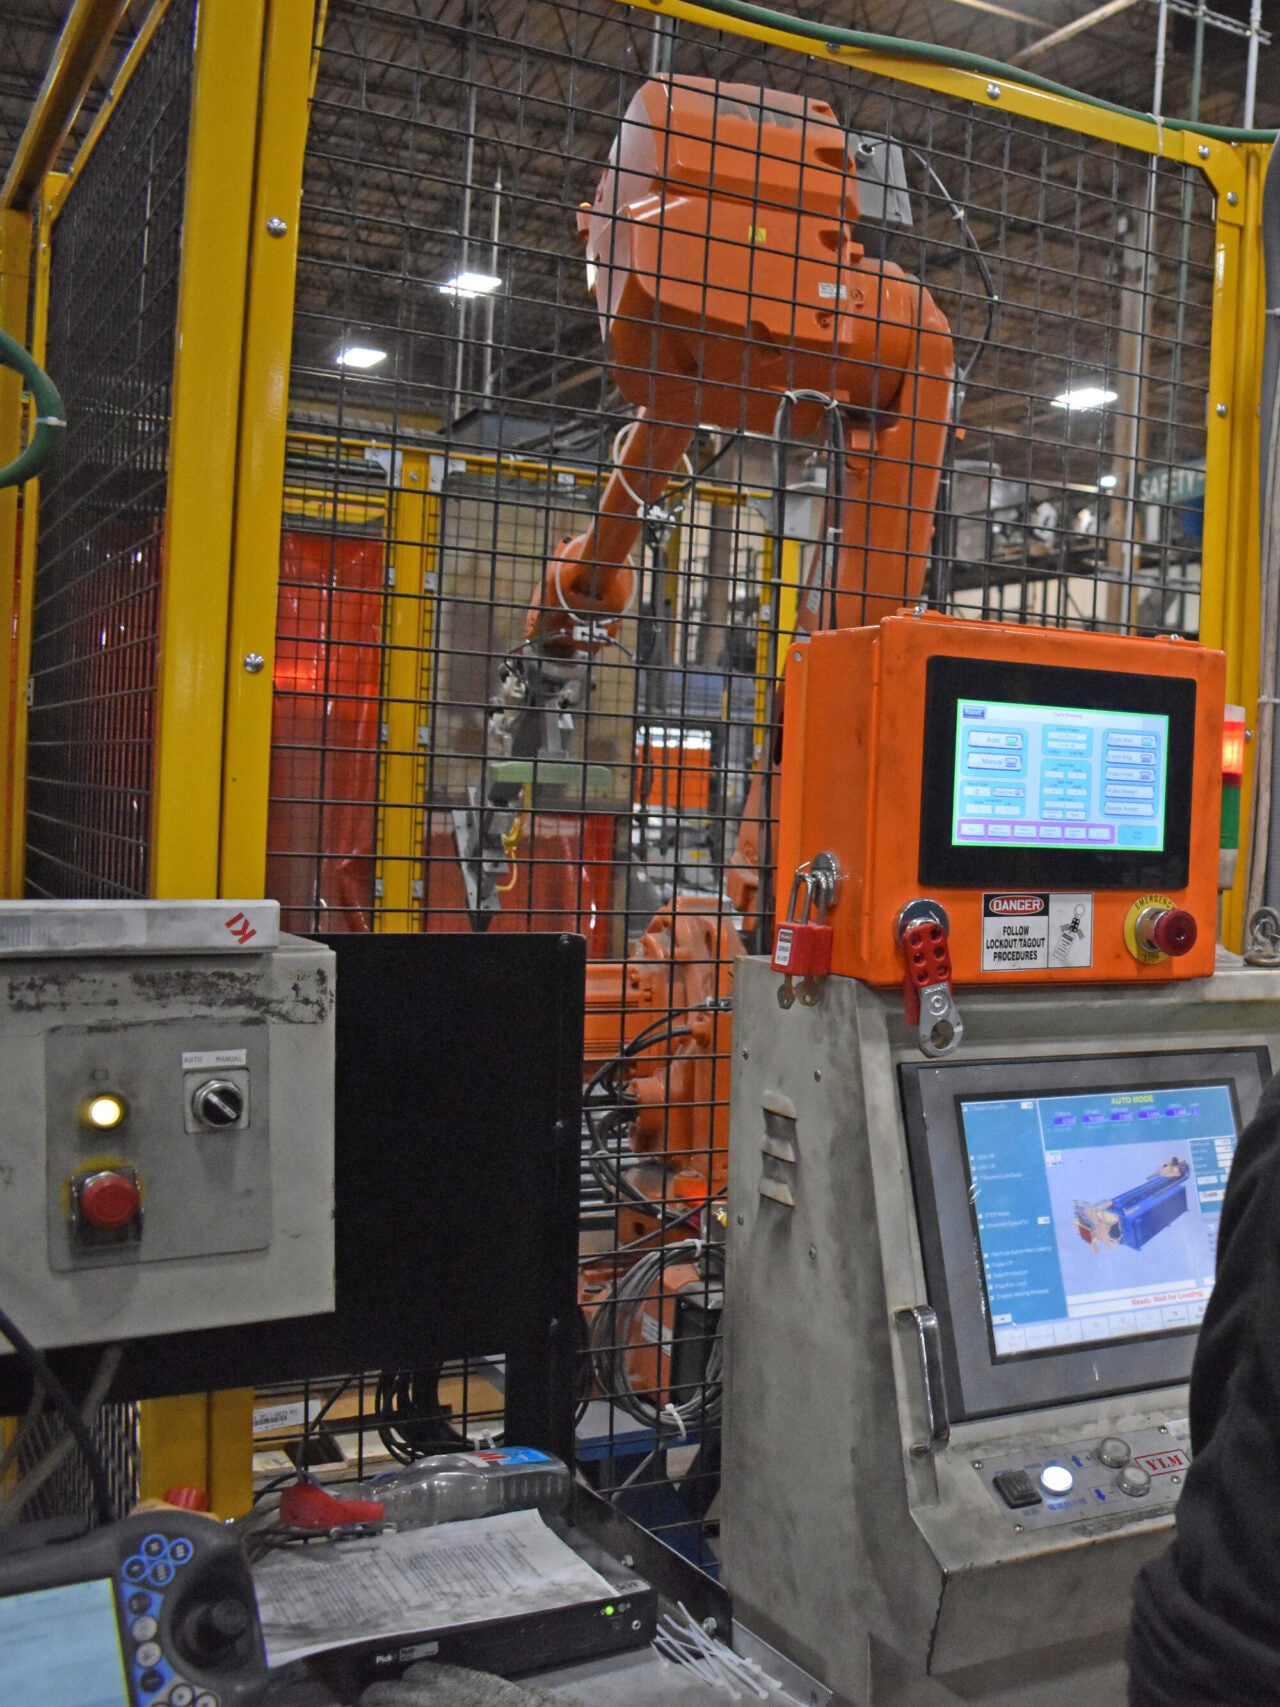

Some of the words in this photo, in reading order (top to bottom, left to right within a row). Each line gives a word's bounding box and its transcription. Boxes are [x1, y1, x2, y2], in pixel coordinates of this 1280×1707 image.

[1140, 469, 1196, 500] SAFETY
[993, 899, 1041, 911] DANGER
[1003, 926, 1030, 935] FOLLOW
[993, 950, 1038, 962] PROCEDURES
[216, 1055, 243, 1063] MANUAL
[1111, 1097, 1132, 1105] AUTO
[1145, 1454, 1183, 1470] YLM
